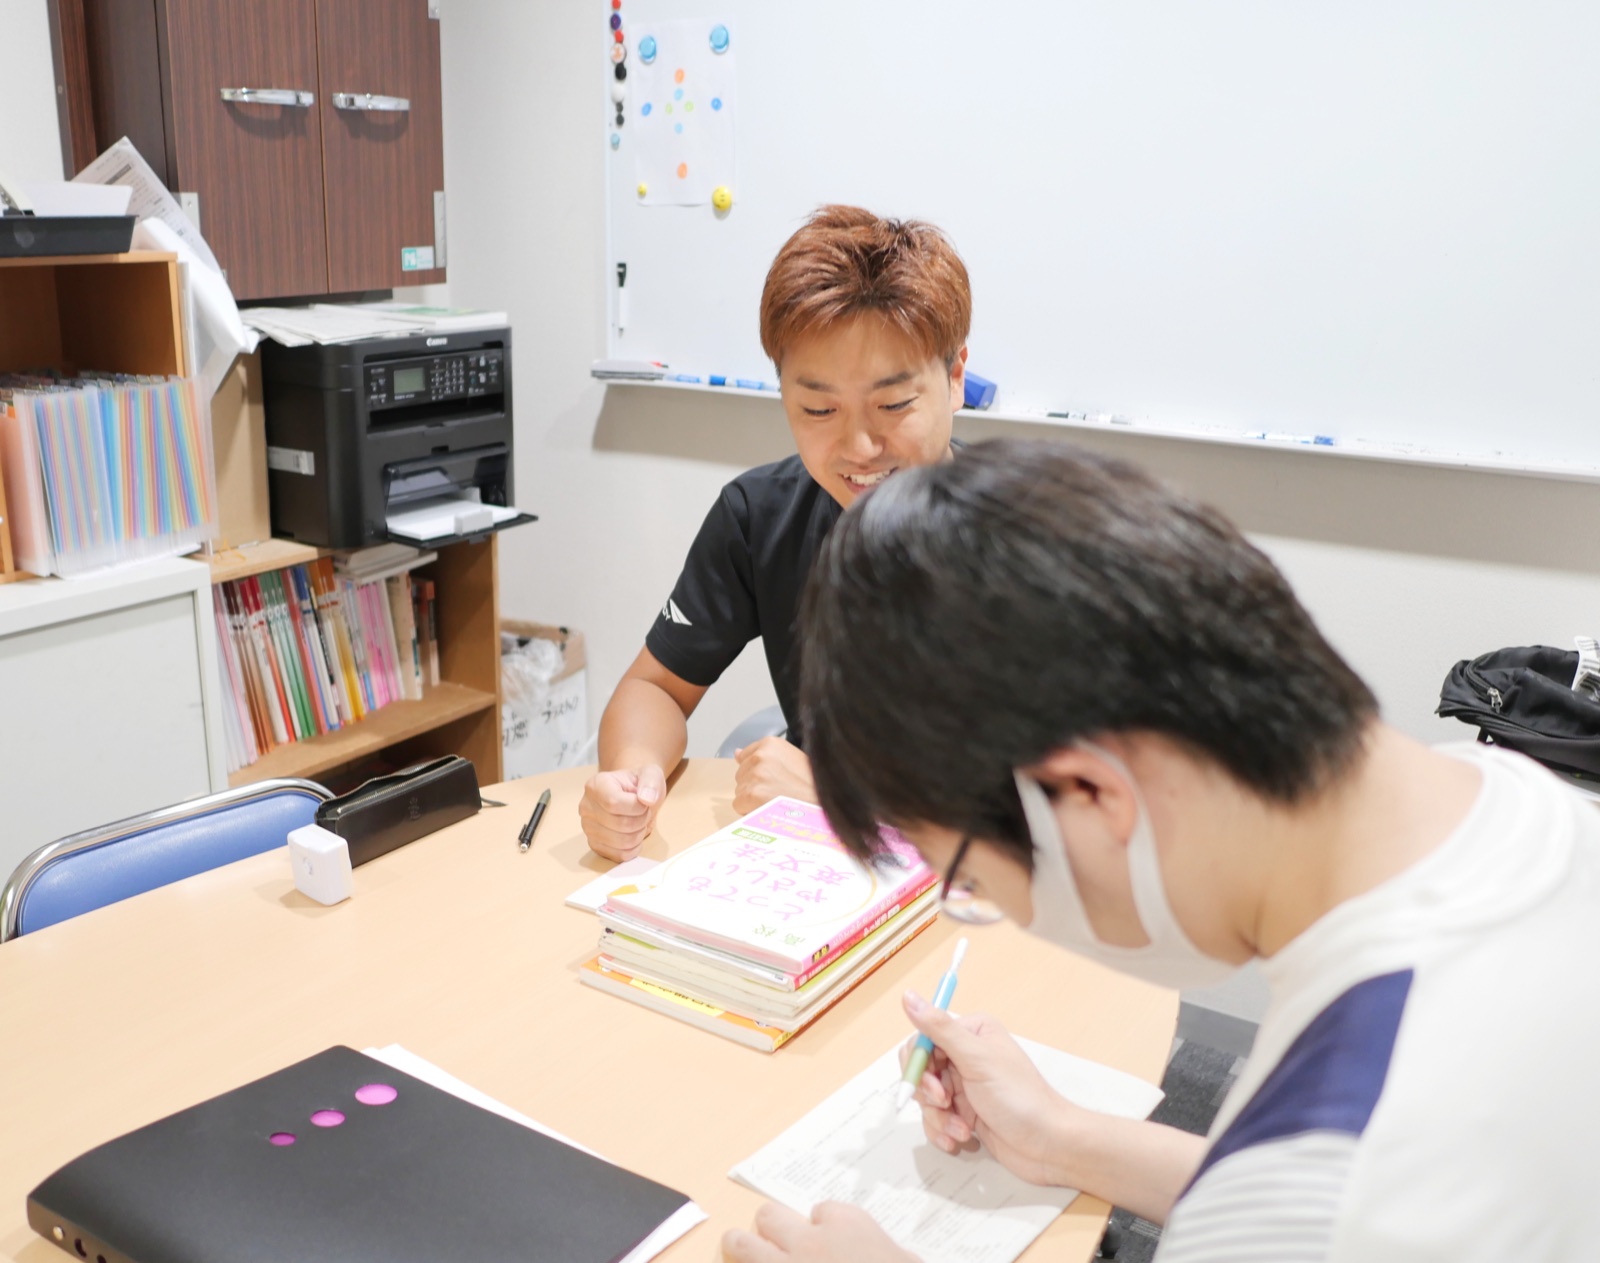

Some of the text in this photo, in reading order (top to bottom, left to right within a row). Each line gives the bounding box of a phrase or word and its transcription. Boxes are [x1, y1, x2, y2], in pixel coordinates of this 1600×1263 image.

[426, 336, 448, 347] Canon
[708, 861, 828, 904] やさしい
[732, 843, 856, 886] 英文法
[687, 876, 805, 921] とっても
[753, 923, 807, 946] 高校
